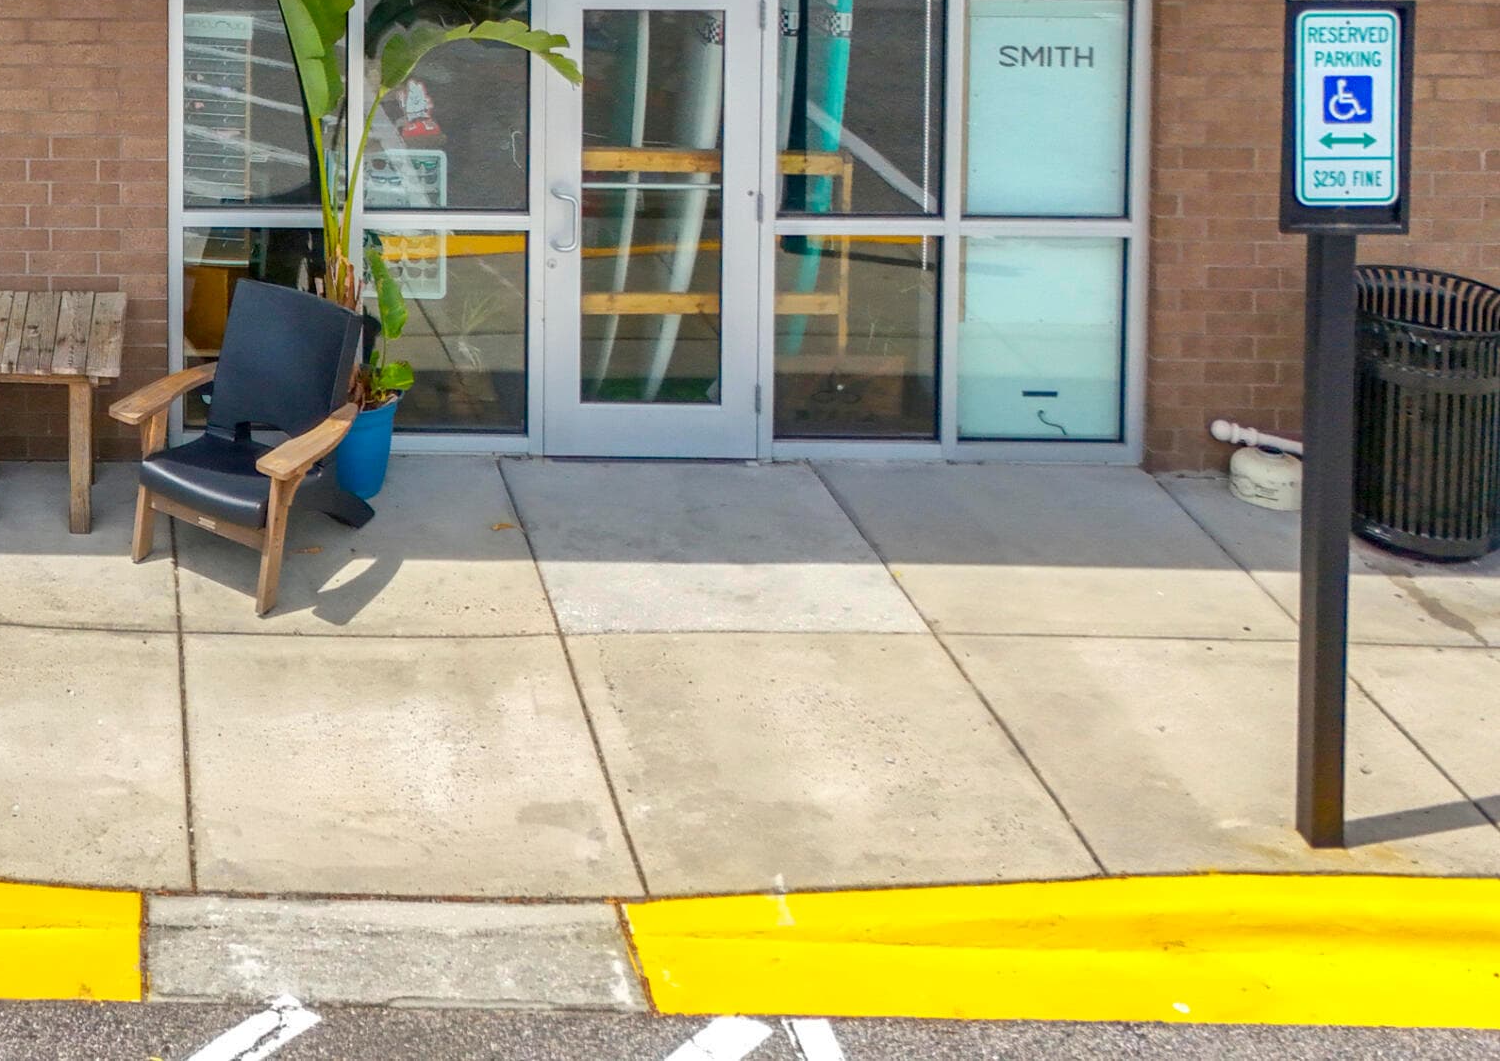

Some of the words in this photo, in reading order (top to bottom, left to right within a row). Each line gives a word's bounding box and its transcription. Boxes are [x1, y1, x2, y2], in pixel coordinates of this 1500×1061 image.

[1307, 26, 1389, 43] RESERVED
[999, 45, 1093, 67] SMITH
[1314, 50, 1382, 67] PARKING
[1313, 169, 1346, 188] $250
[1352, 170, 1382, 187] FINE
